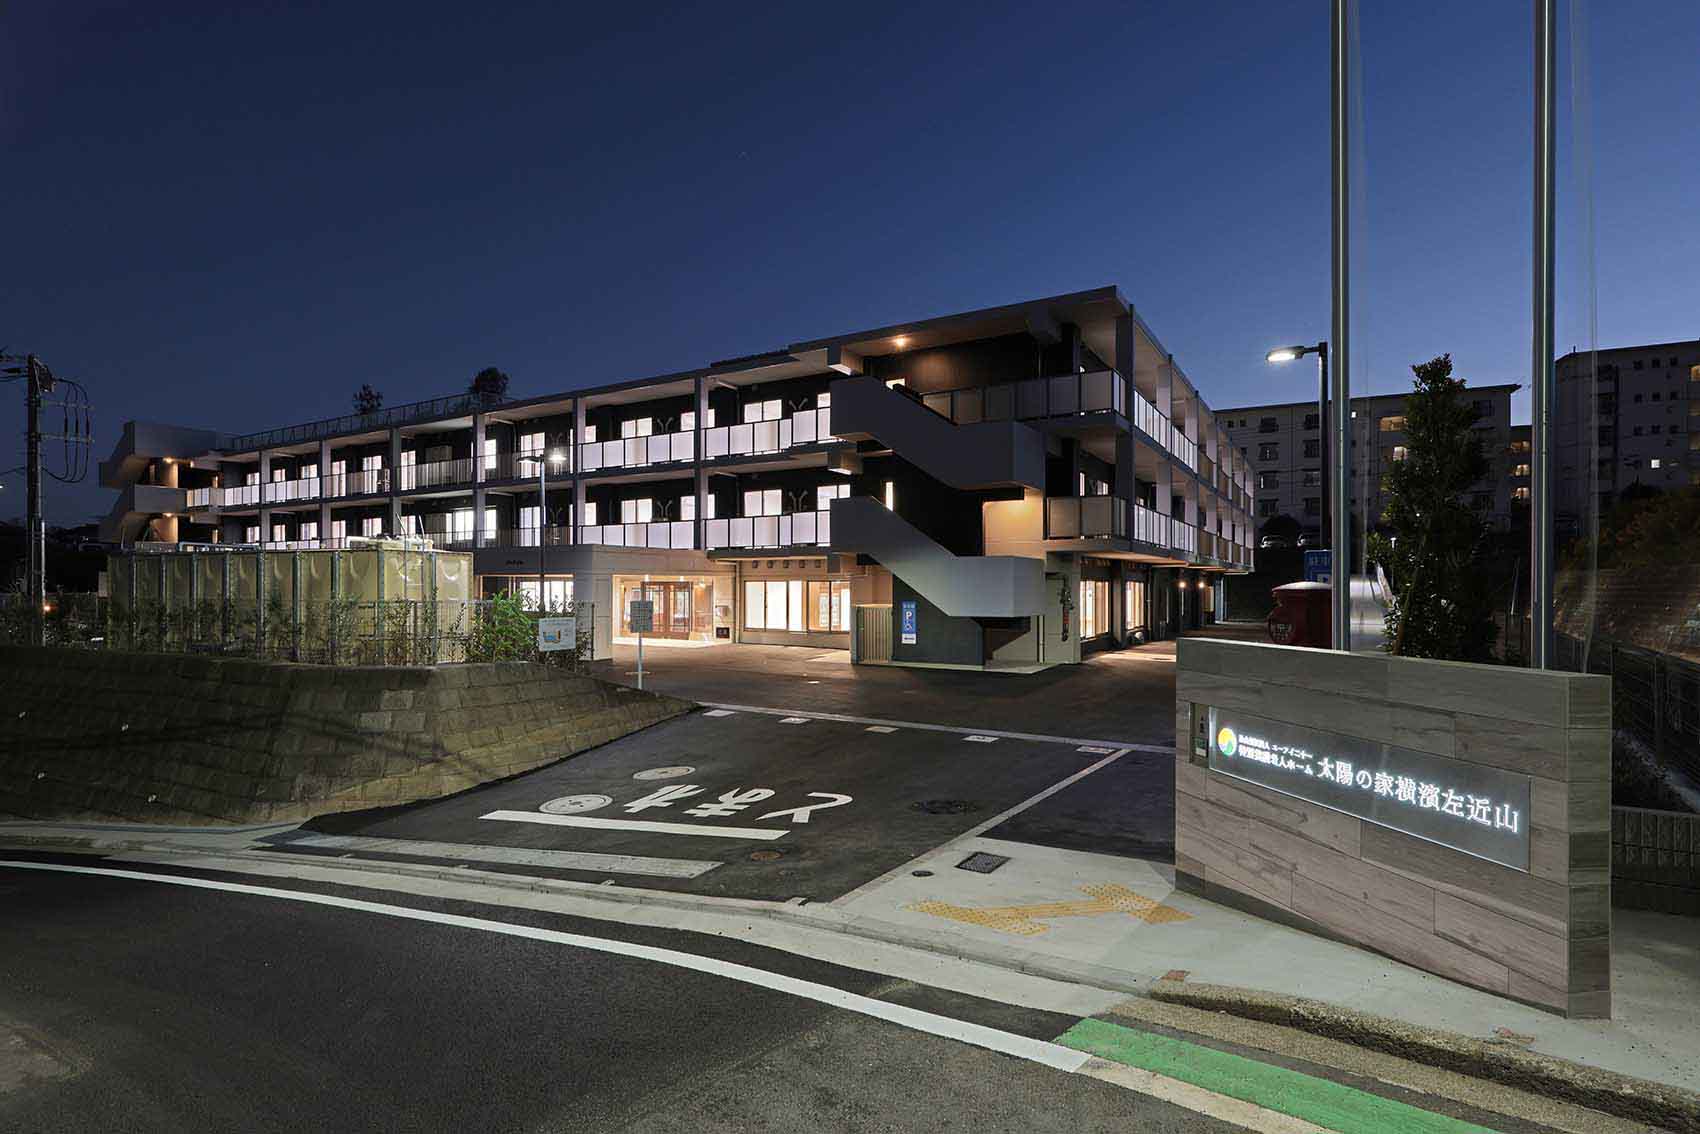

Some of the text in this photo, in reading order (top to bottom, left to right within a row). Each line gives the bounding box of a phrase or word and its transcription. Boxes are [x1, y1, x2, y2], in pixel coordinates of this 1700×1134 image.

[1238, 744, 1313, 775] 老人ホーム
[624, 785, 852, 823] とまれ
[1317, 757, 1519, 833] 太陽の家横濱左近山
